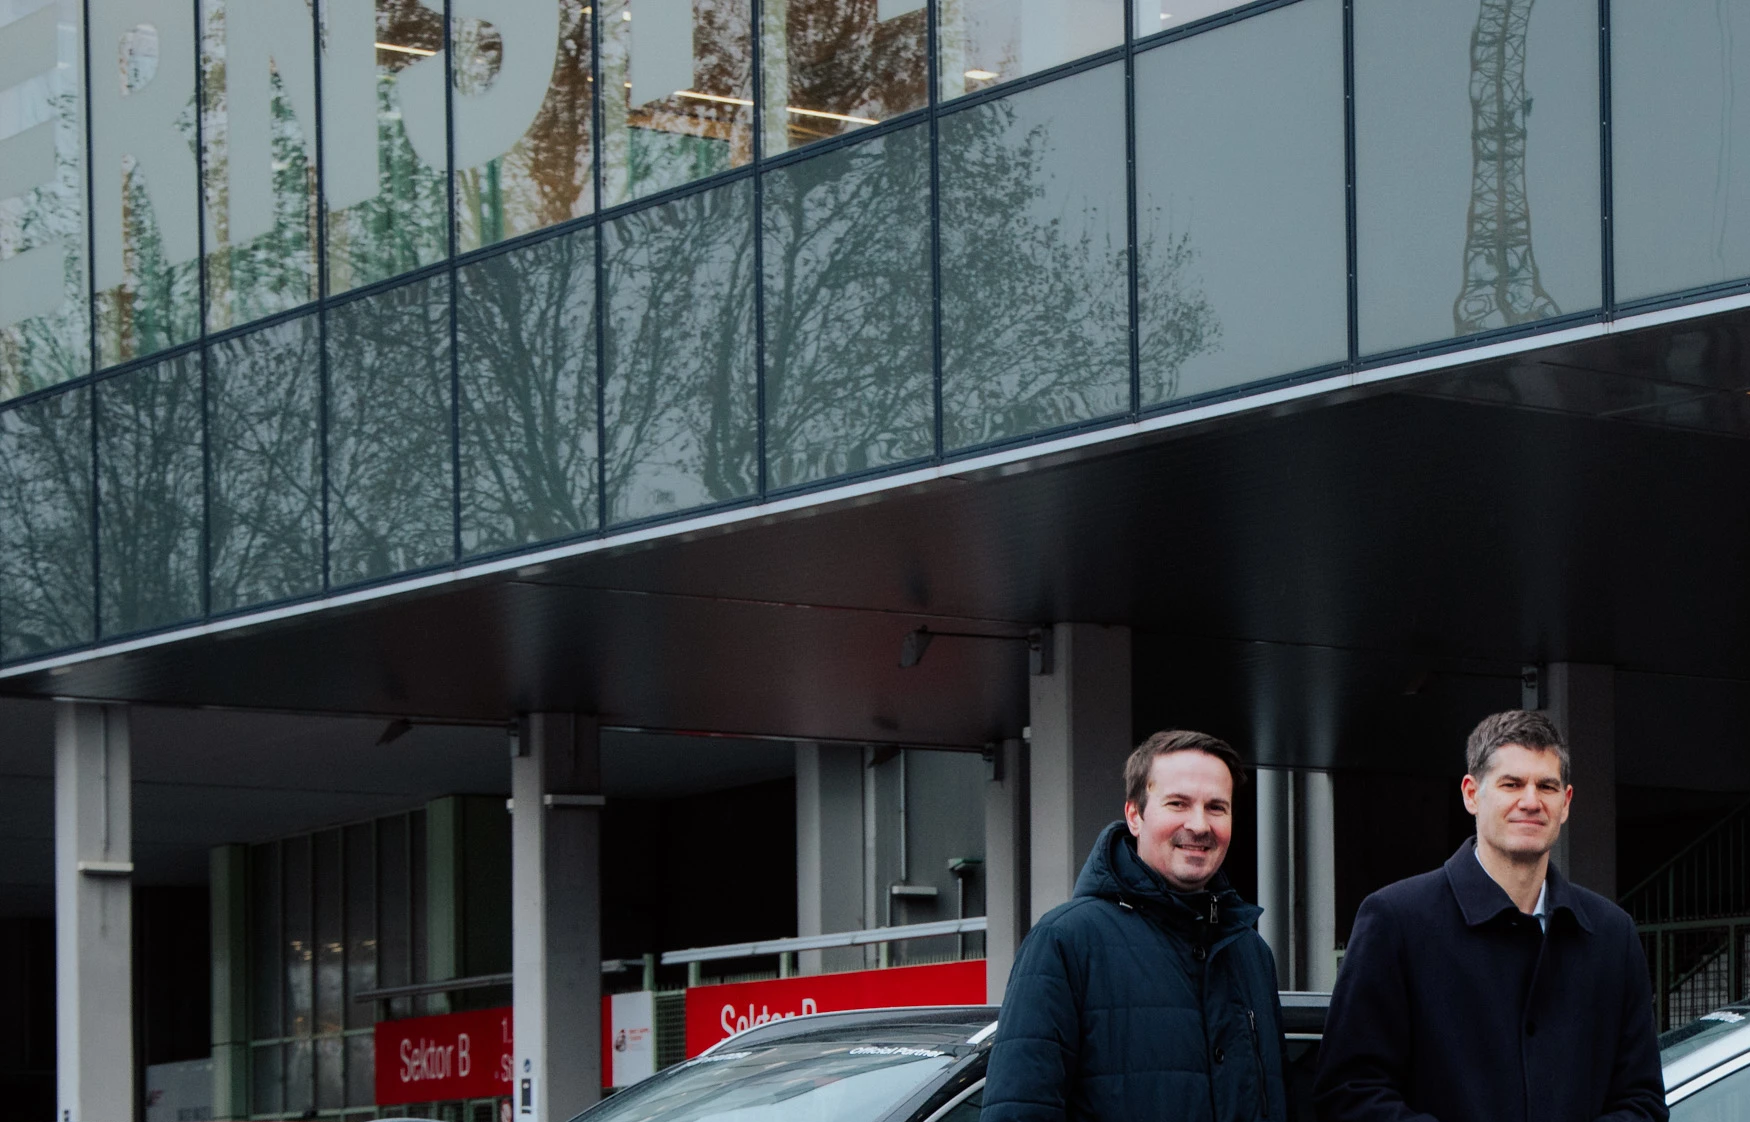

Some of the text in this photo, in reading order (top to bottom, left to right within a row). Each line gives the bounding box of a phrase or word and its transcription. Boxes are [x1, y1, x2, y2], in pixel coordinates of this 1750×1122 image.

[0, 0, 695, 328] ERN
[720, 1003, 796, 1042] Sekt
[400, 1038, 454, 1083] Sektor
[458, 1033, 471, 1078] B
